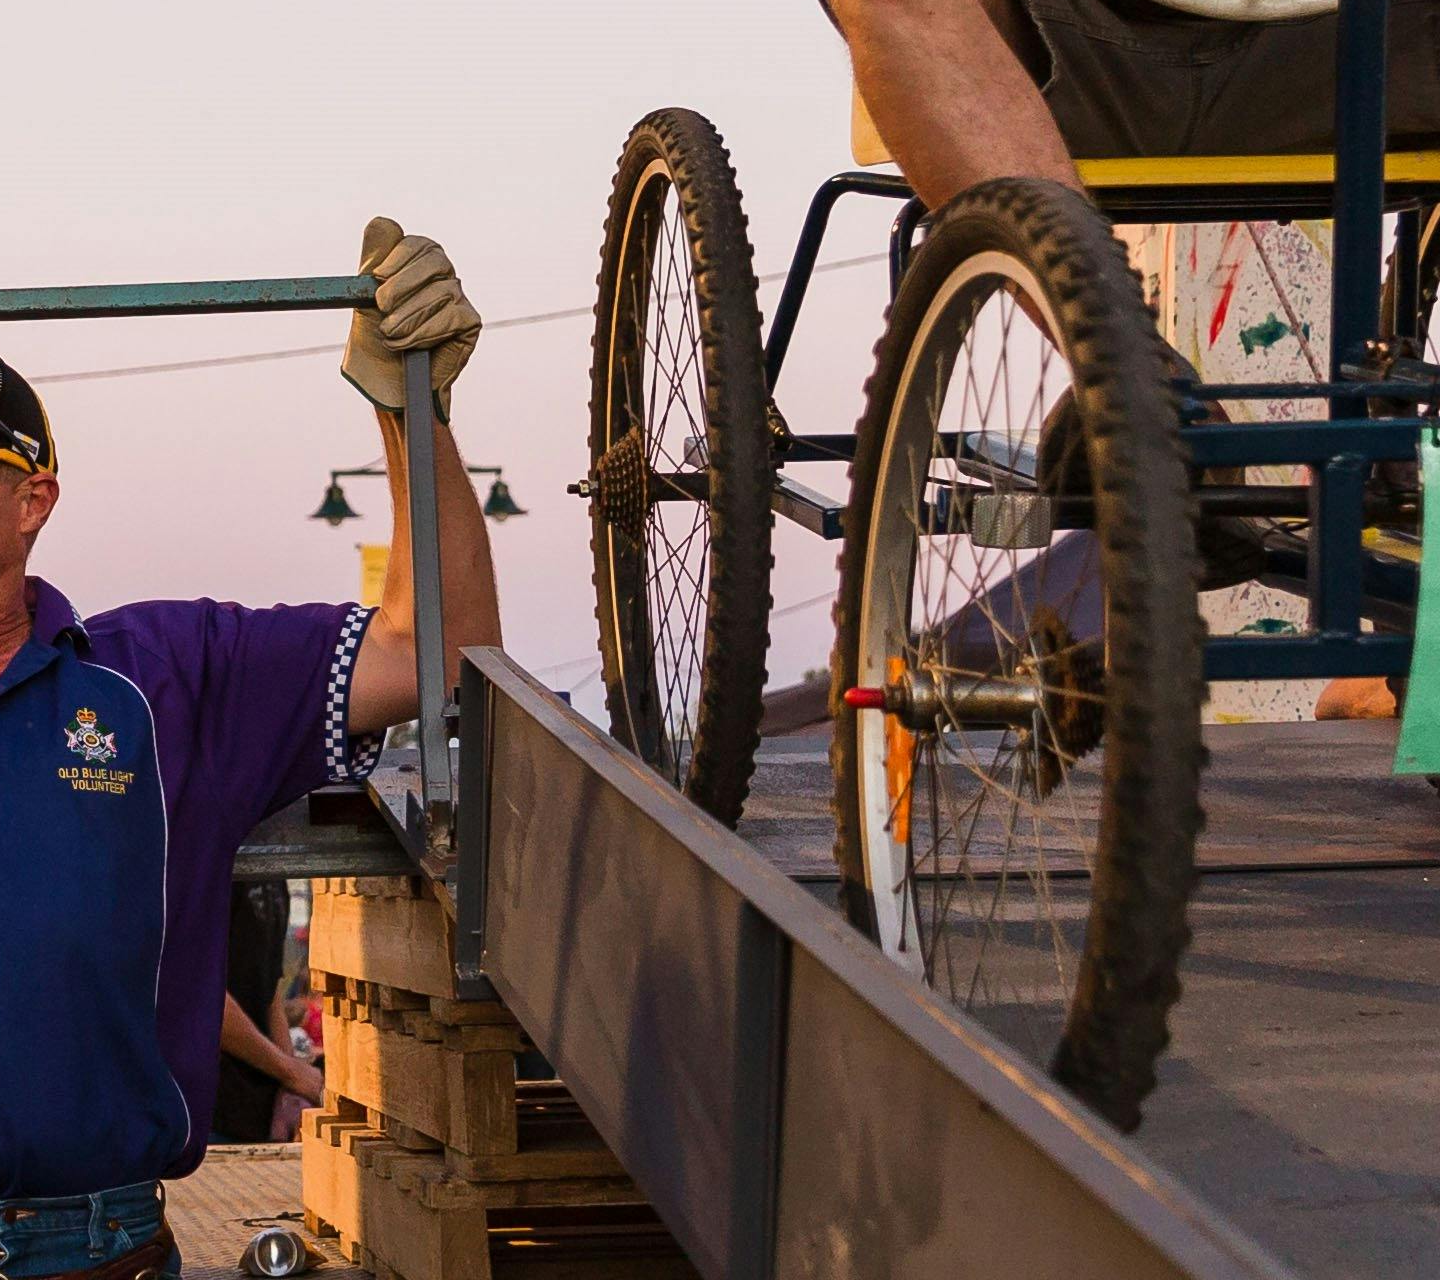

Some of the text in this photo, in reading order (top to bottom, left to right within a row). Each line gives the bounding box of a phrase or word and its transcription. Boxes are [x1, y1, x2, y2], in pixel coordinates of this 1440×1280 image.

[82, 767, 108, 780] BLUE
[110, 770, 134, 783] LIGHT
[71, 779, 125, 795] VOLUNTEER
